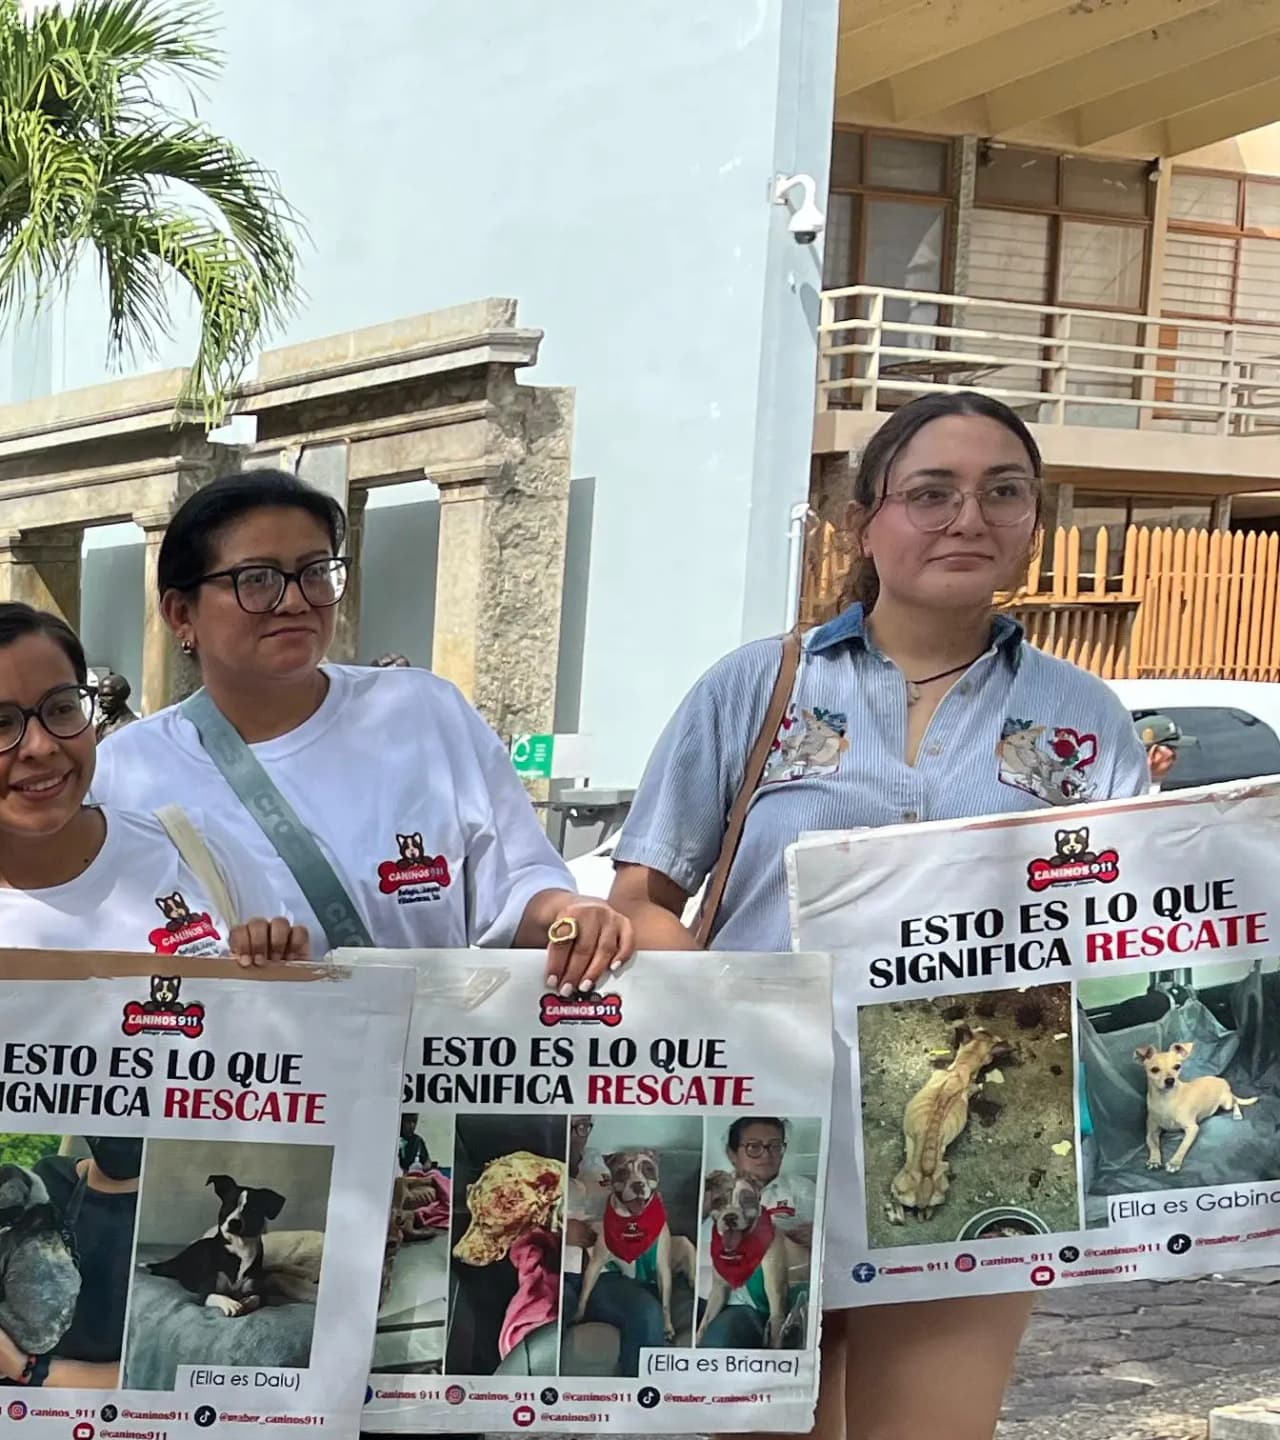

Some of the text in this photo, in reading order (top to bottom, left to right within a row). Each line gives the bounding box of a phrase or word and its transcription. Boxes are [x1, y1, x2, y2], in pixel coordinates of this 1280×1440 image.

[388, 868, 430, 882] CANINOS
[1034, 862, 1113, 880] CANINOS 911
[900, 878, 1237, 948] ESTO ES LO QUE
[161, 925, 204, 947] CANINOS
[869, 912, 1270, 989] SIGNIFICA RESCATE
[545, 1005, 616, 1016] CANINOS 911
[128, 1014, 198, 1027] CANINOS 911
[422, 1036, 728, 1074] ESTO ES LO QUE
[3, 1043, 303, 1088] ESTO ES LO QUE
[587, 1074, 755, 1107] RESCATE
[163, 1087, 327, 1125] RESCATE
[1110, 1201, 1156, 1223] (Ella
[1163, 1201, 1188, 1214] es
[980, 1253, 1053, 1267] caninos_911
[879, 1262, 949, 1275] Caninos 911
[647, 1353, 799, 1377] (Ella es Briana)
[190, 1369, 300, 1392] (Ella es Dalu)
[375, 1390, 440, 1400] Caninos 911
[468, 1391, 536, 1402] caninos_911
[562, 1392, 632, 1402] @caninos911
[30, 1409, 96, 1419] caninos_911
[121, 1410, 190, 1421] @caninos911
[540, 1412, 610, 1423] @caninos911
[99, 1429, 168, 1440] @caninos911
